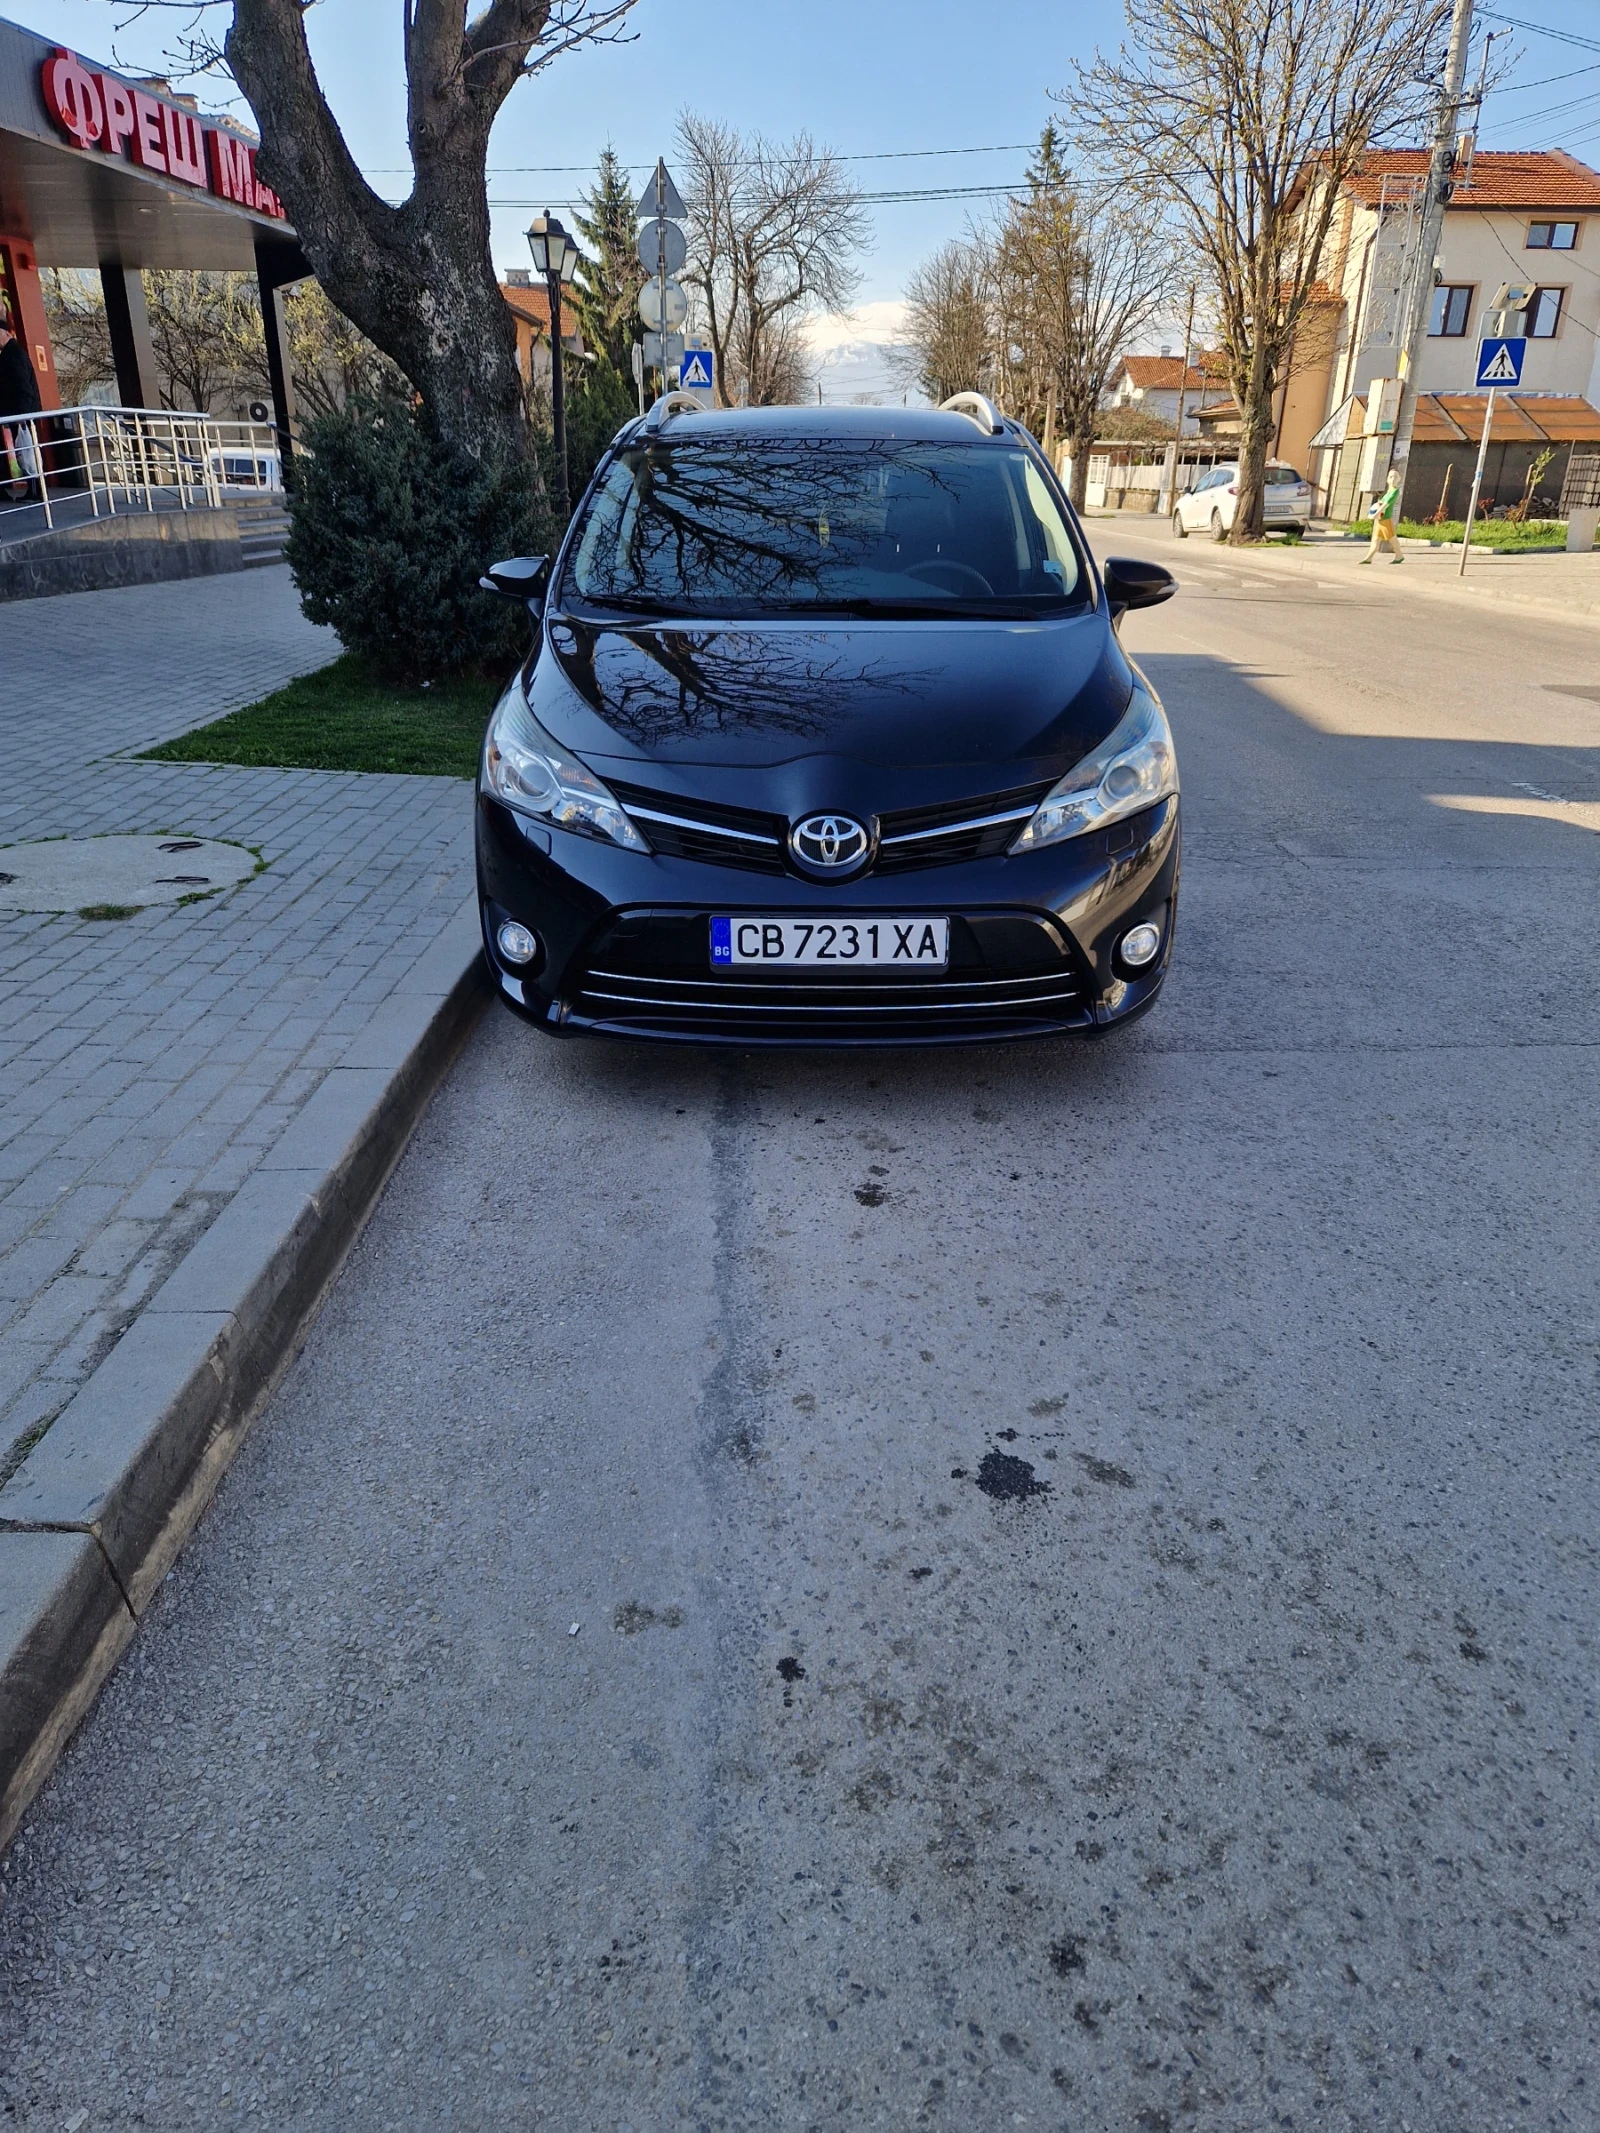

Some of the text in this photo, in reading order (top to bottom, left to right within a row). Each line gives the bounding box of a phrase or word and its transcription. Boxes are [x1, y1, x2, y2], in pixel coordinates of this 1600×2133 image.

[42, 47, 286, 219] ФРЕШ МА
[714, 946, 730, 956] BG
[737, 924, 938, 959] CB 7231 XA
